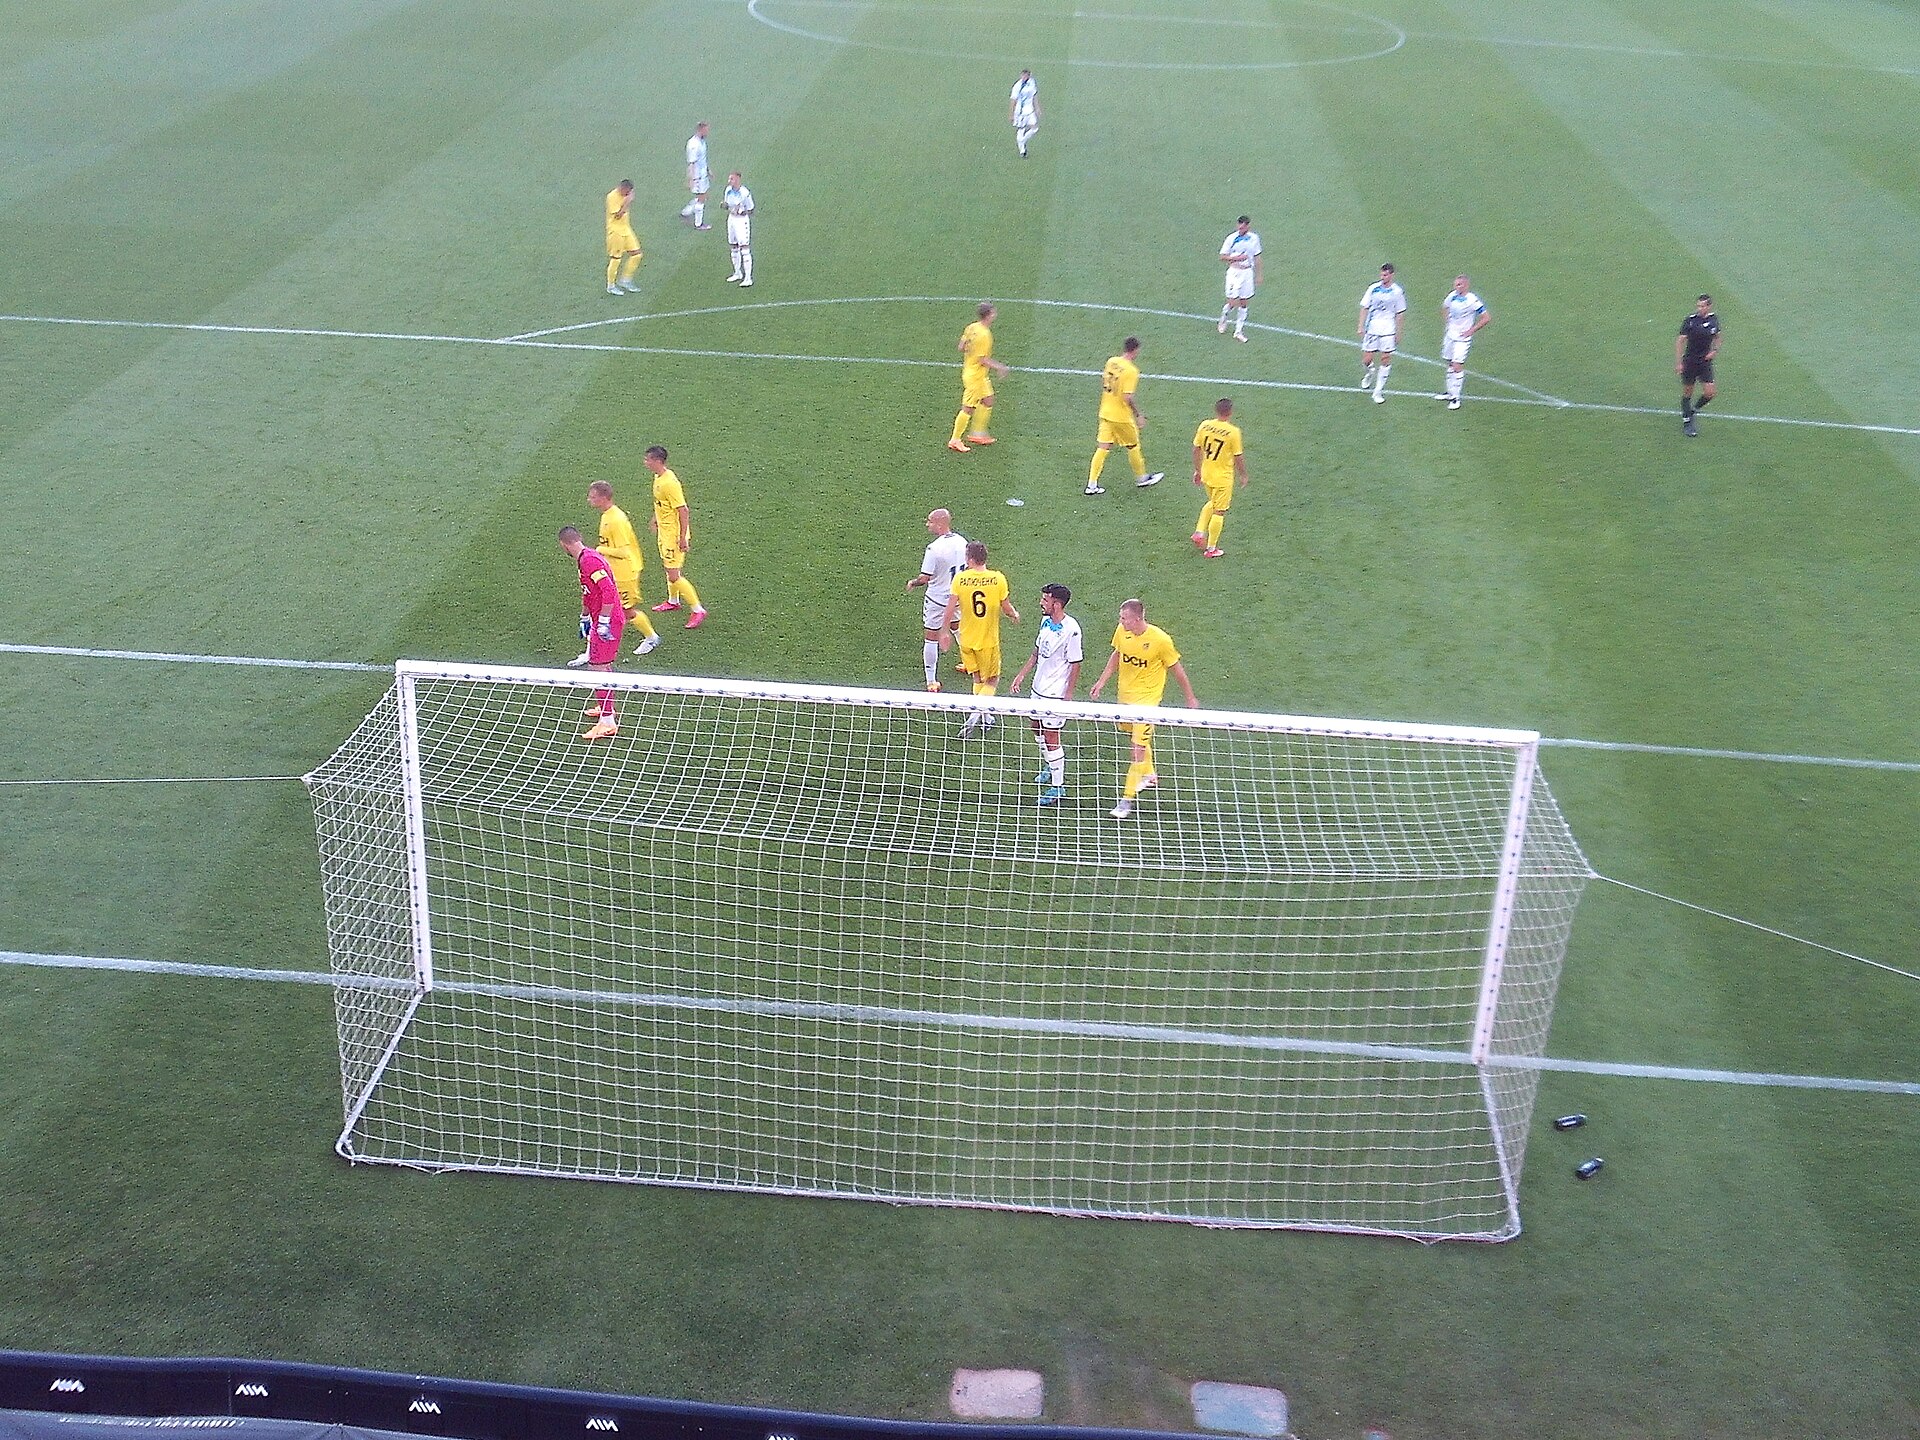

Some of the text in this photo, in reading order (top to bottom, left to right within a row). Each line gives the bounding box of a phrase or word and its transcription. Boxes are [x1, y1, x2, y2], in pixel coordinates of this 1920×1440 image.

[1204, 435, 1224, 461] 47
[972, 590, 986, 617] 6
[1123, 653, 1147, 668] DCH
